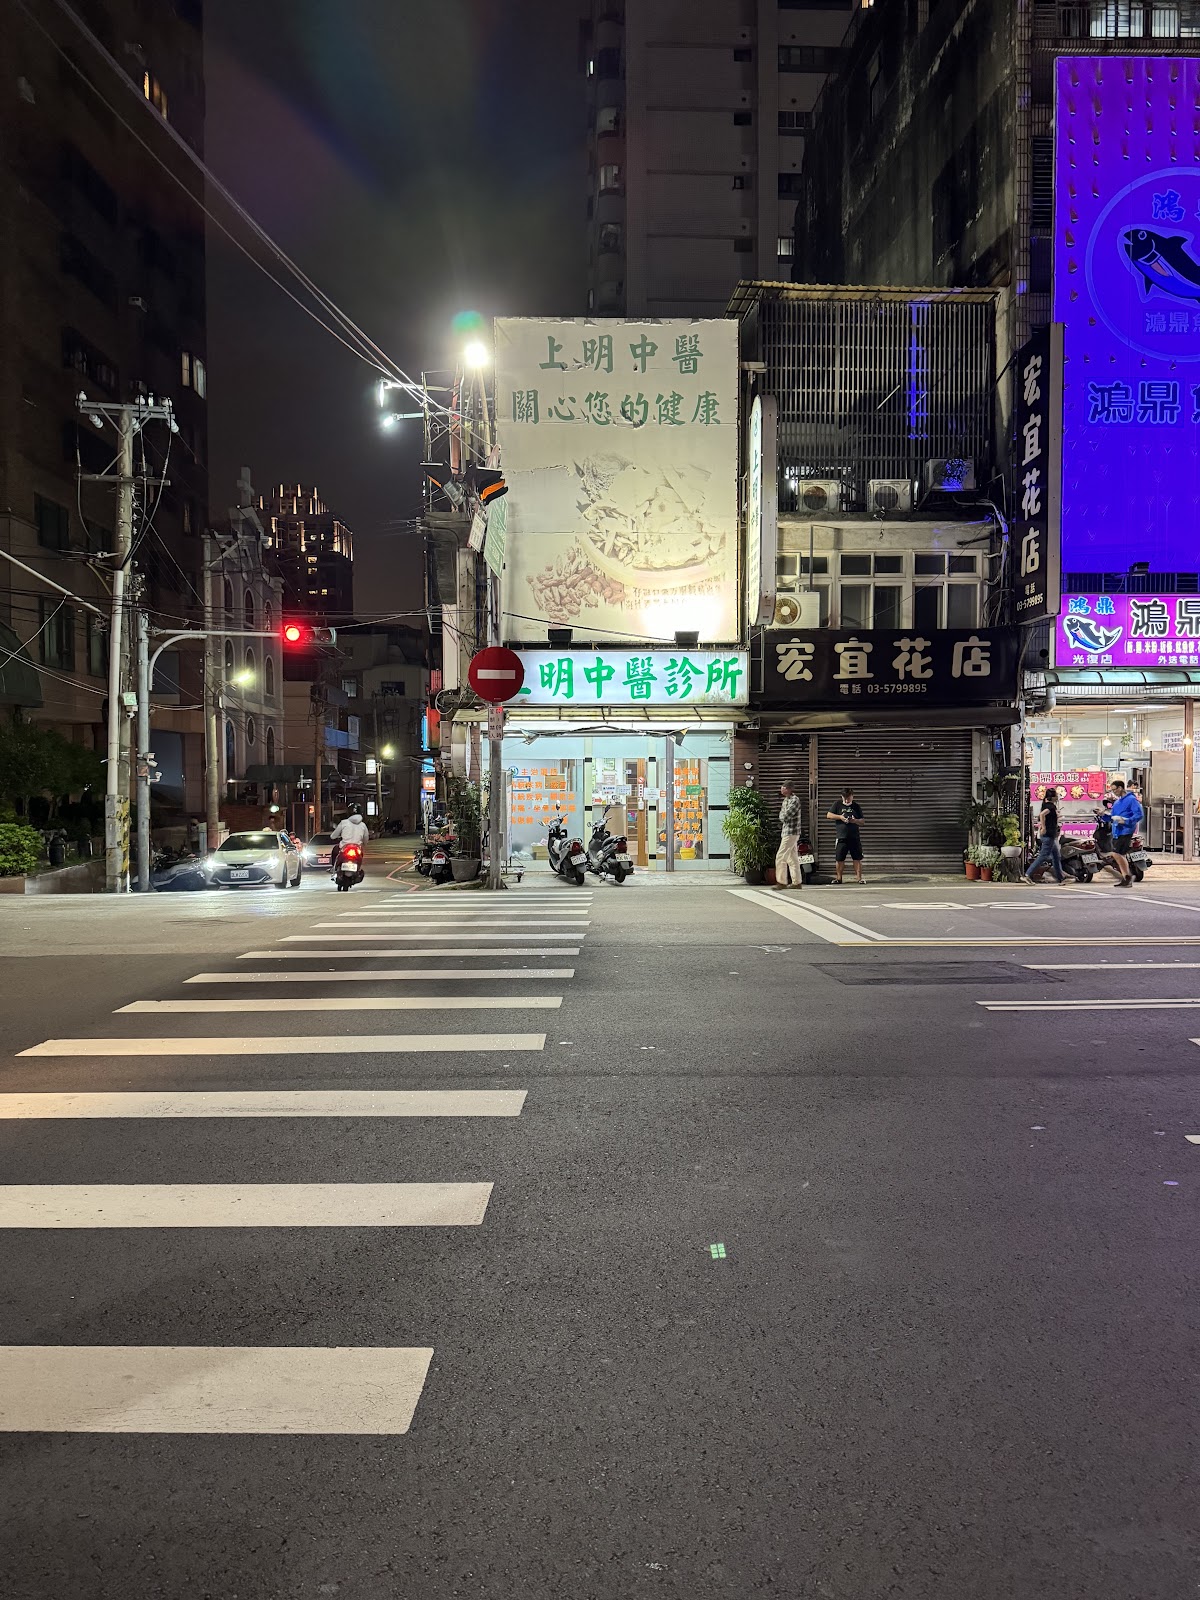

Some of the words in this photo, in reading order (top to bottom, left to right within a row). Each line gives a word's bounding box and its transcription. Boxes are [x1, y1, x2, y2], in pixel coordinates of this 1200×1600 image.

[1152, 188, 1200, 223] 鴻
[539, 333, 704, 375] 上明中醫
[512, 389, 721, 428] 關心您的健康
[1088, 380, 1200, 425] 鴻鼎
[1021, 354, 1042, 578] 宏宜花店
[1068, 596, 1116, 616] 鴻鼎
[519, 655, 743, 700] 明中醫診所
[776, 635, 992, 682] 宏宜花店
[1072, 654, 1113, 665] 光復店
[1157, 655, 1200, 665] 外送電話
[839, 684, 862, 695] 電話
[867, 684, 927, 694] 03-5799895
